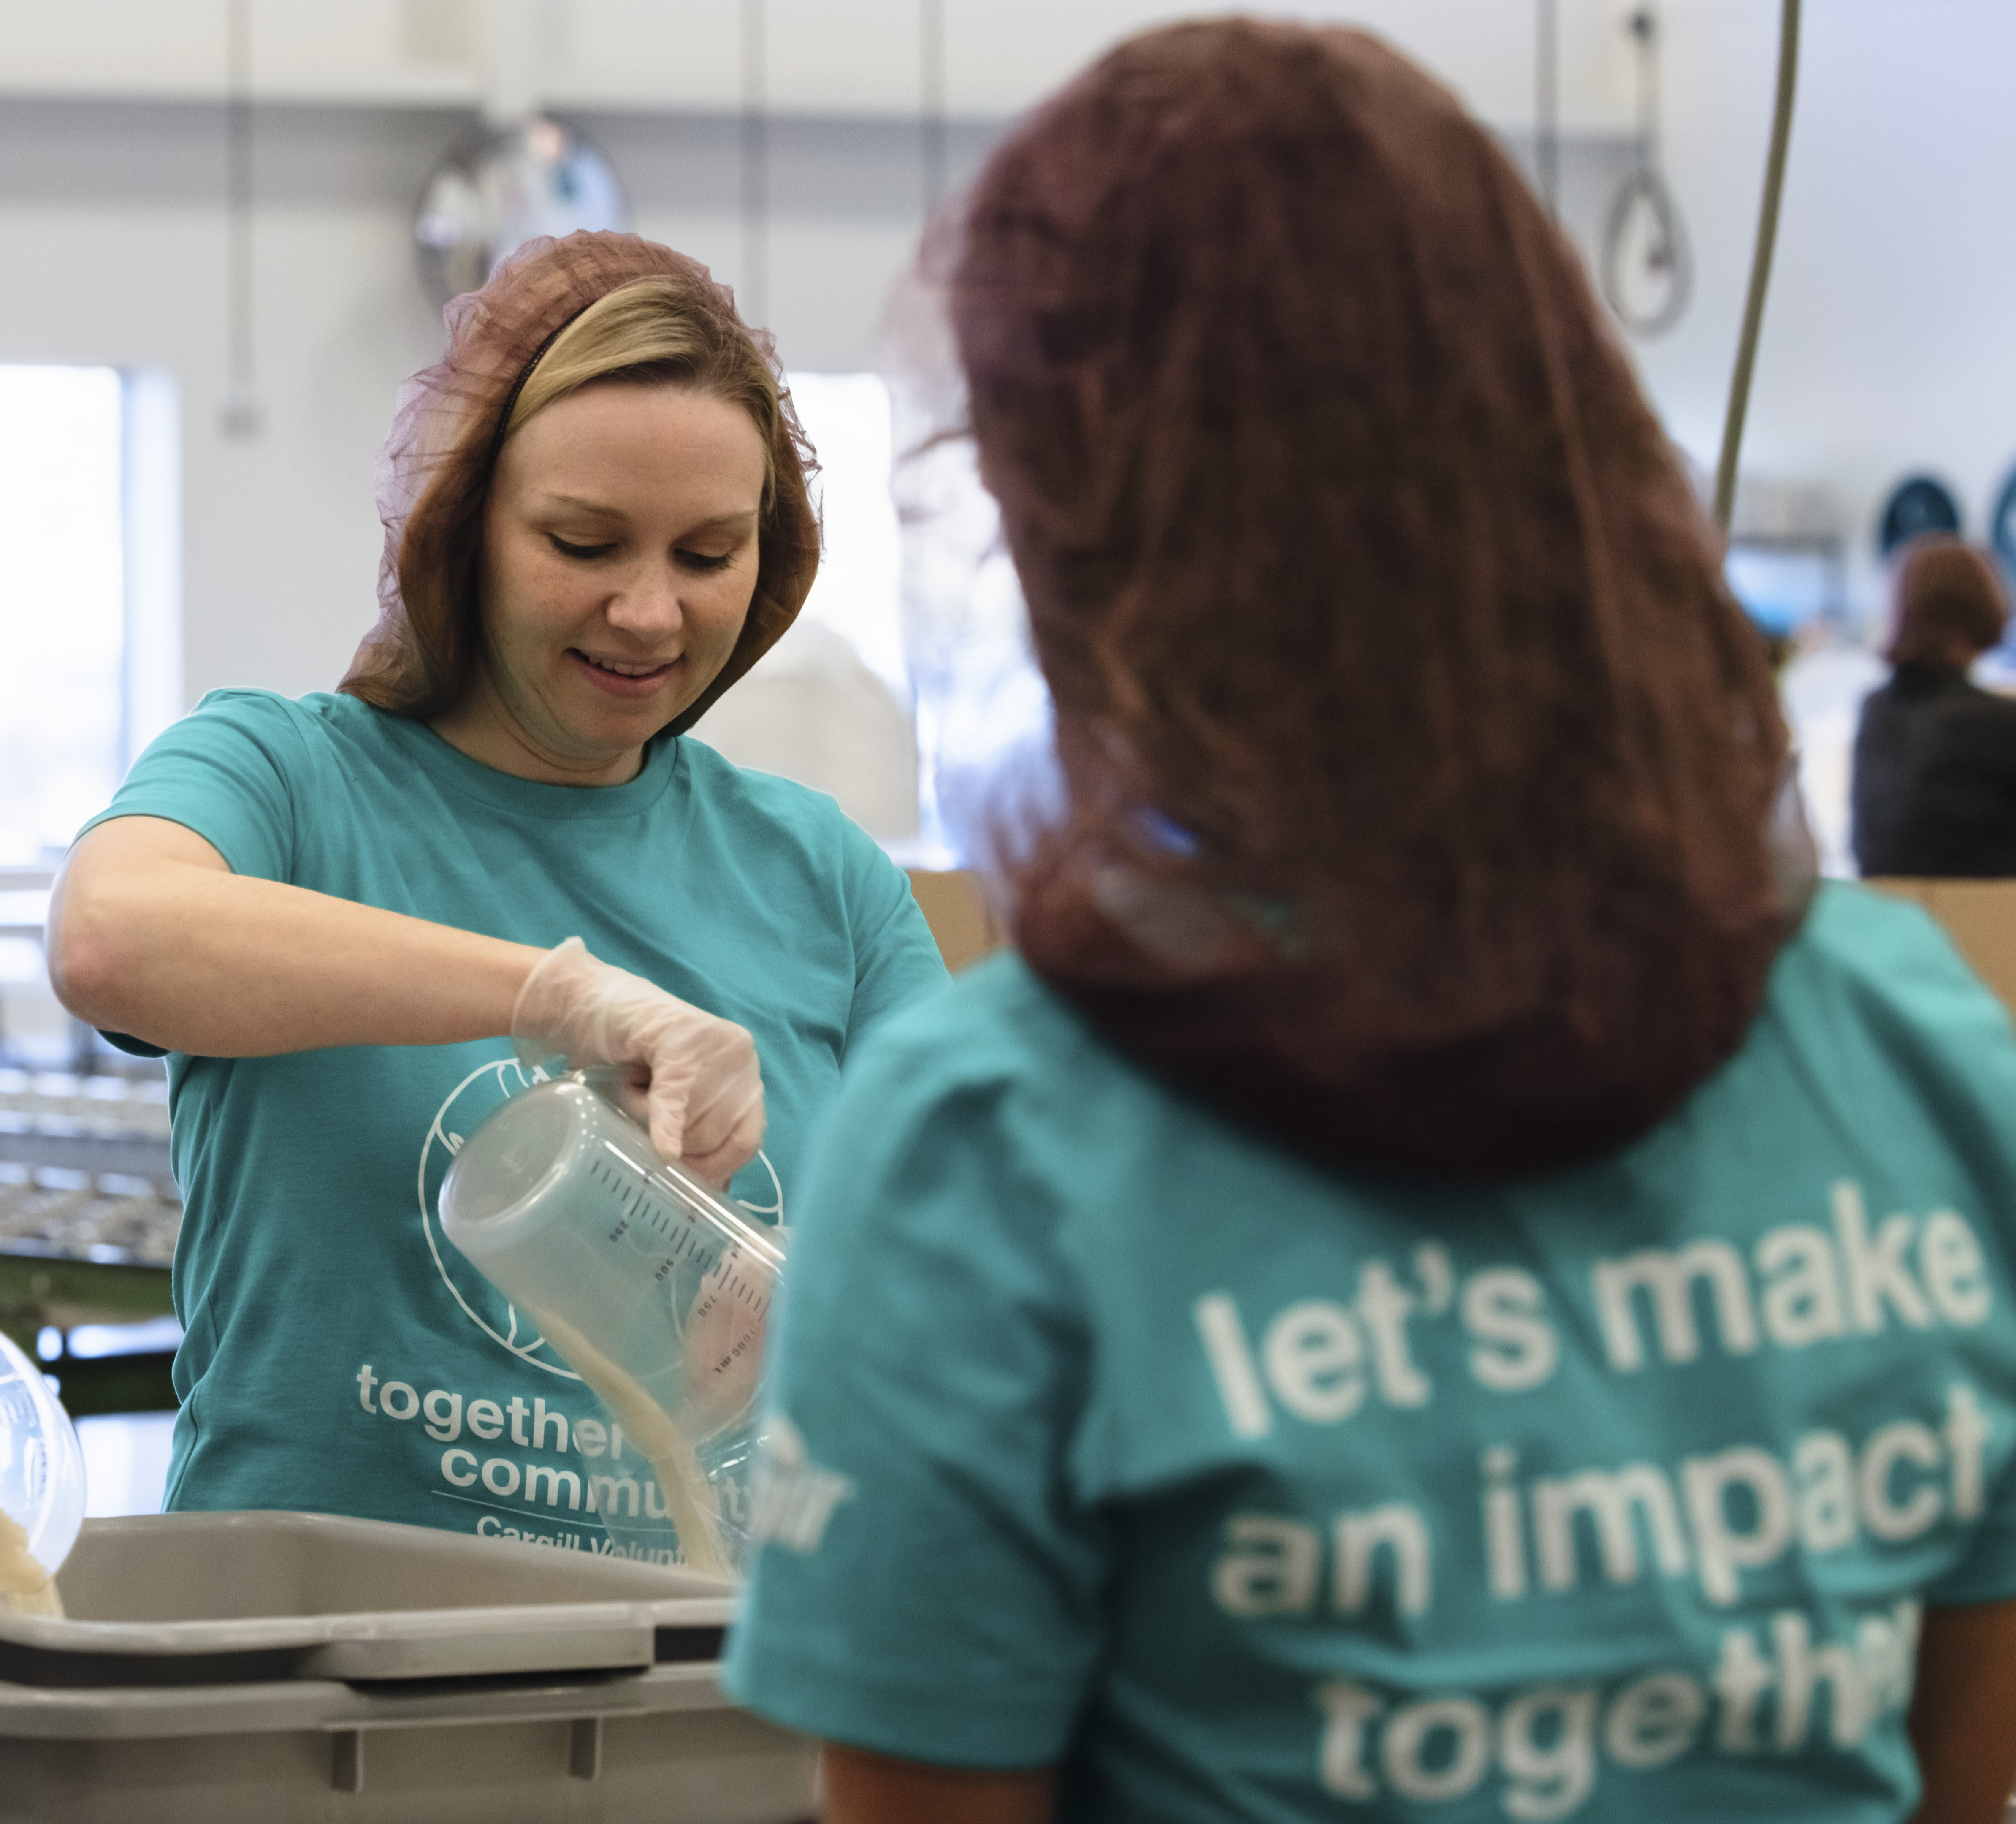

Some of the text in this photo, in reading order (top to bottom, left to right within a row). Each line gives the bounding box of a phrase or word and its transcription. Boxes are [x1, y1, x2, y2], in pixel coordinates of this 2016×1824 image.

[655, 1258, 674, 1281] 500
[697, 1295, 717, 1317] 750
[1195, 1180, 1992, 1439] let's make
[732, 1329, 755, 1357] 1000
[357, 1365, 626, 1460] together
[1211, 1383, 1988, 1617] an impact
